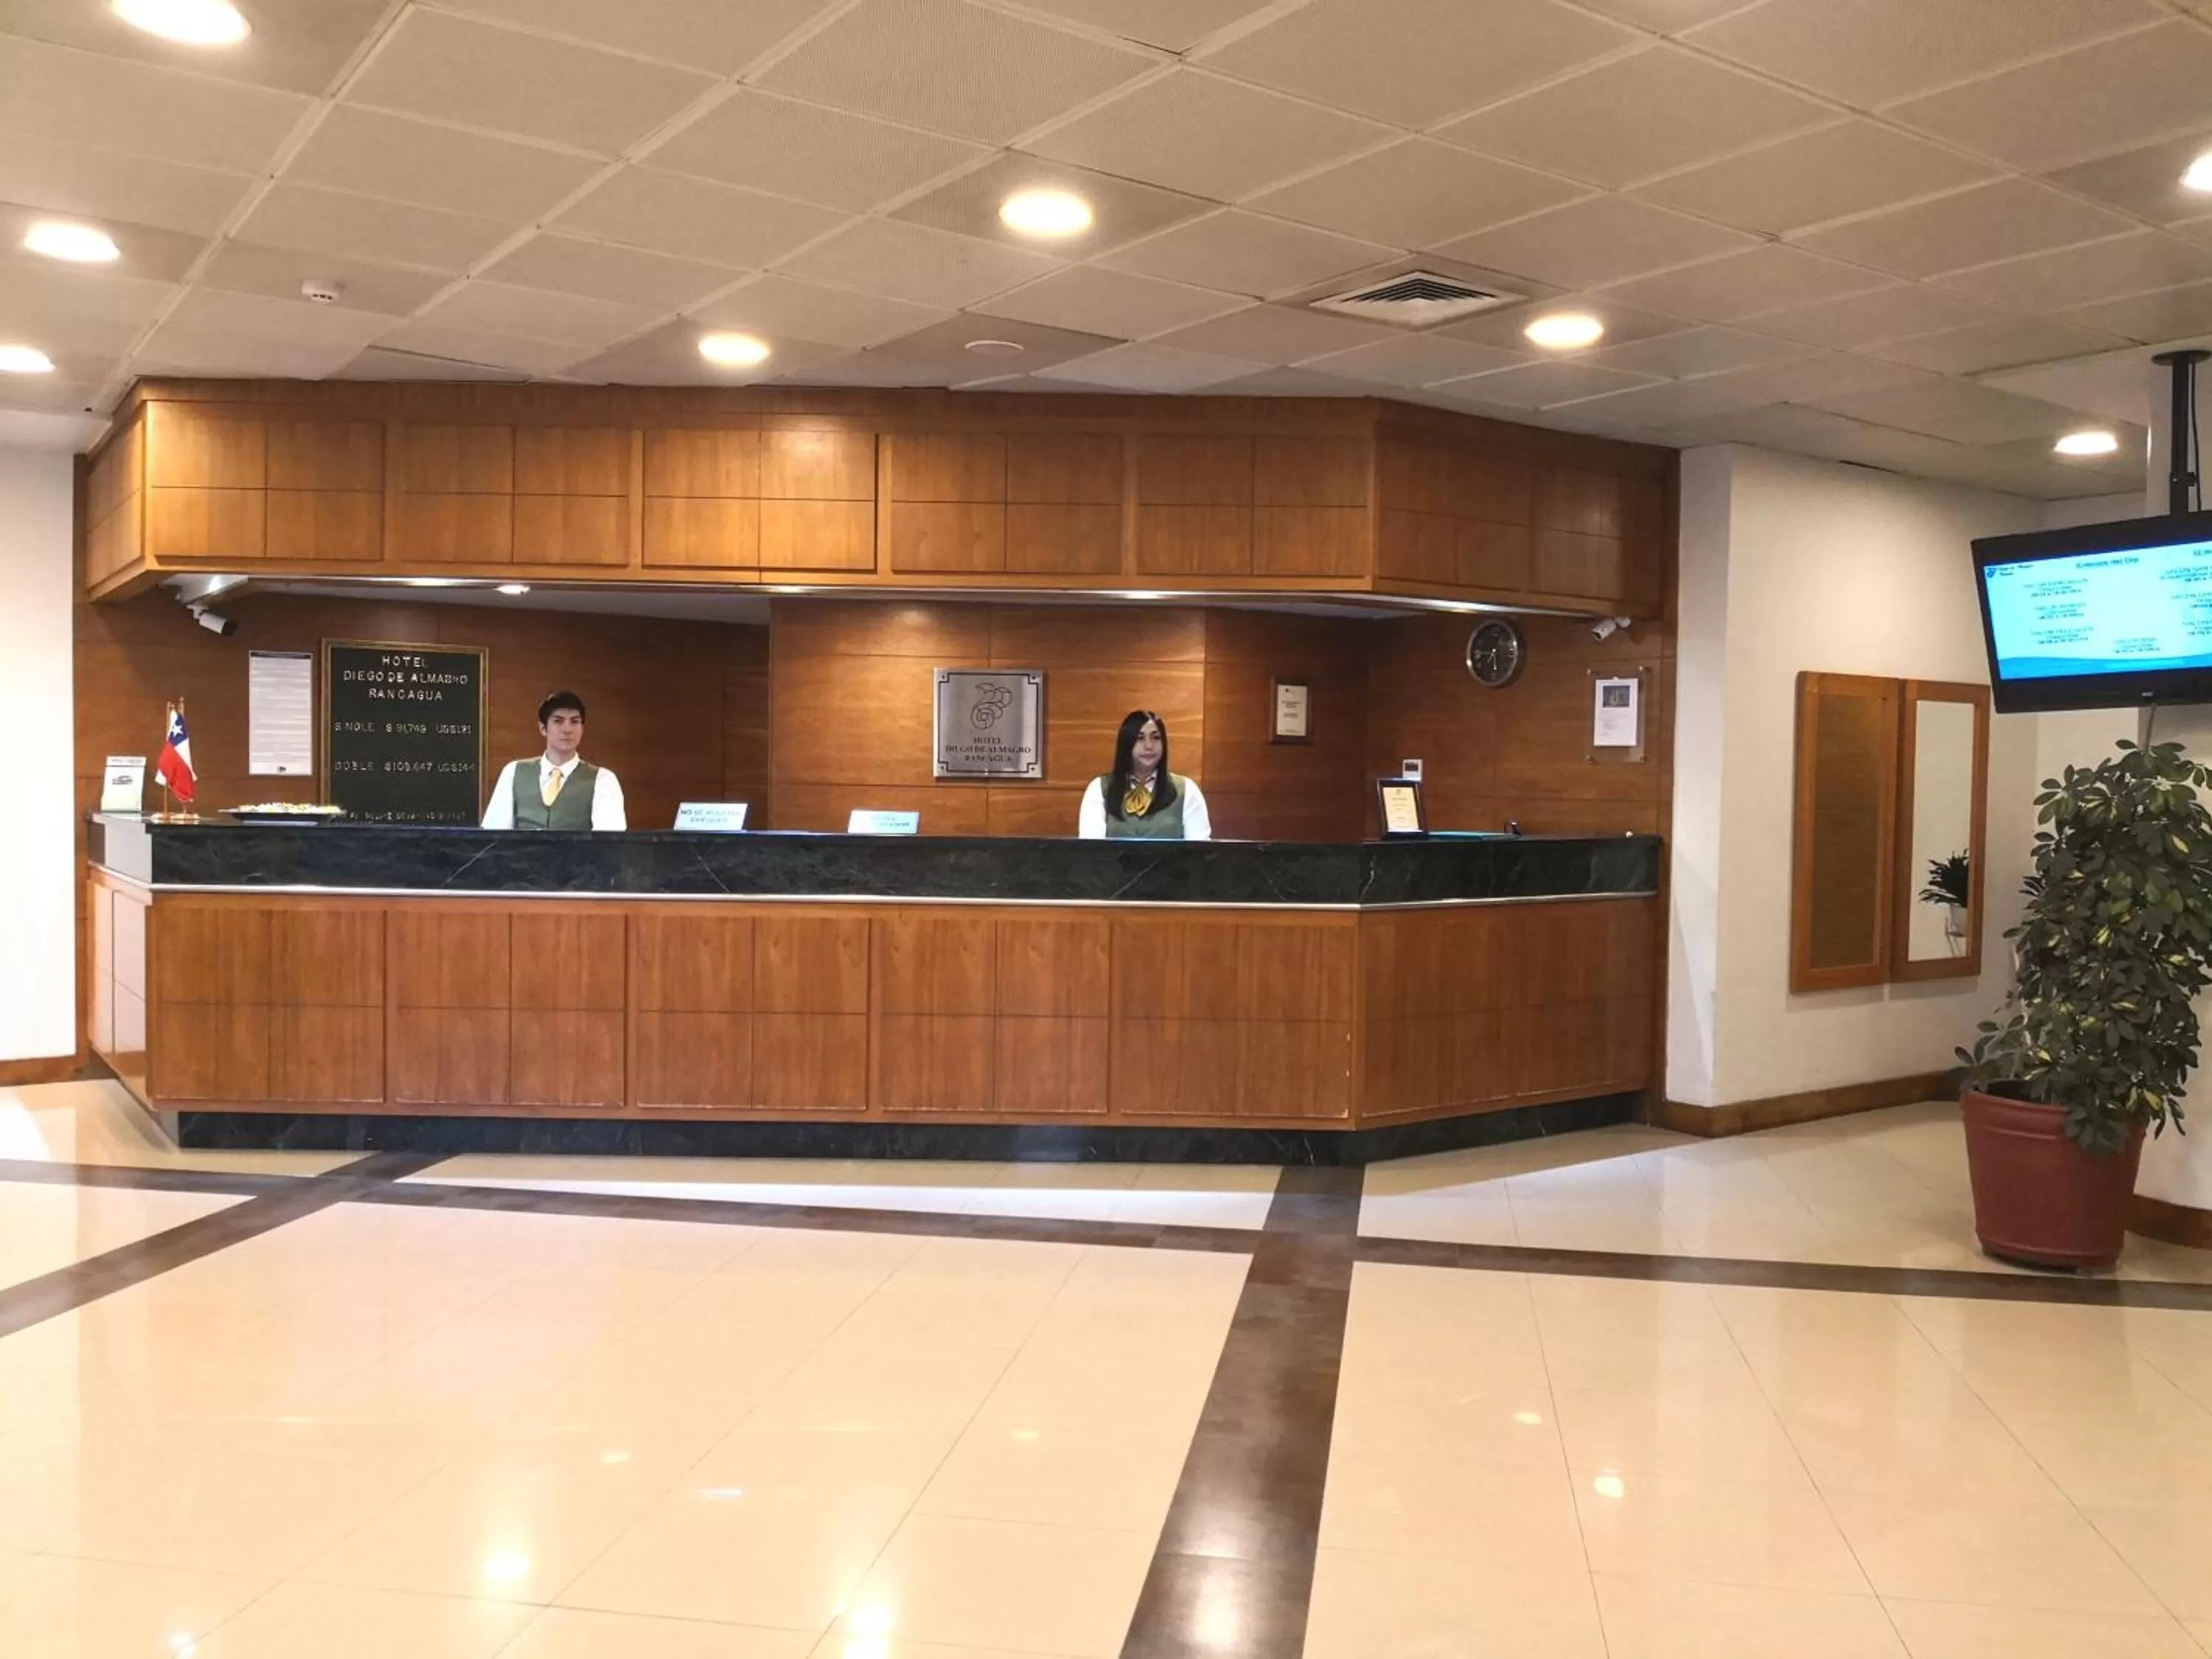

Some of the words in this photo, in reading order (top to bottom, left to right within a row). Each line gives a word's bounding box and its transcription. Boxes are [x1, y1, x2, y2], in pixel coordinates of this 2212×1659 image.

[382, 655, 428, 668] HOTEL
[343, 669, 384, 682] DIEGO
[387, 672, 405, 683] DE
[369, 687, 443, 700] RANCAGUA
